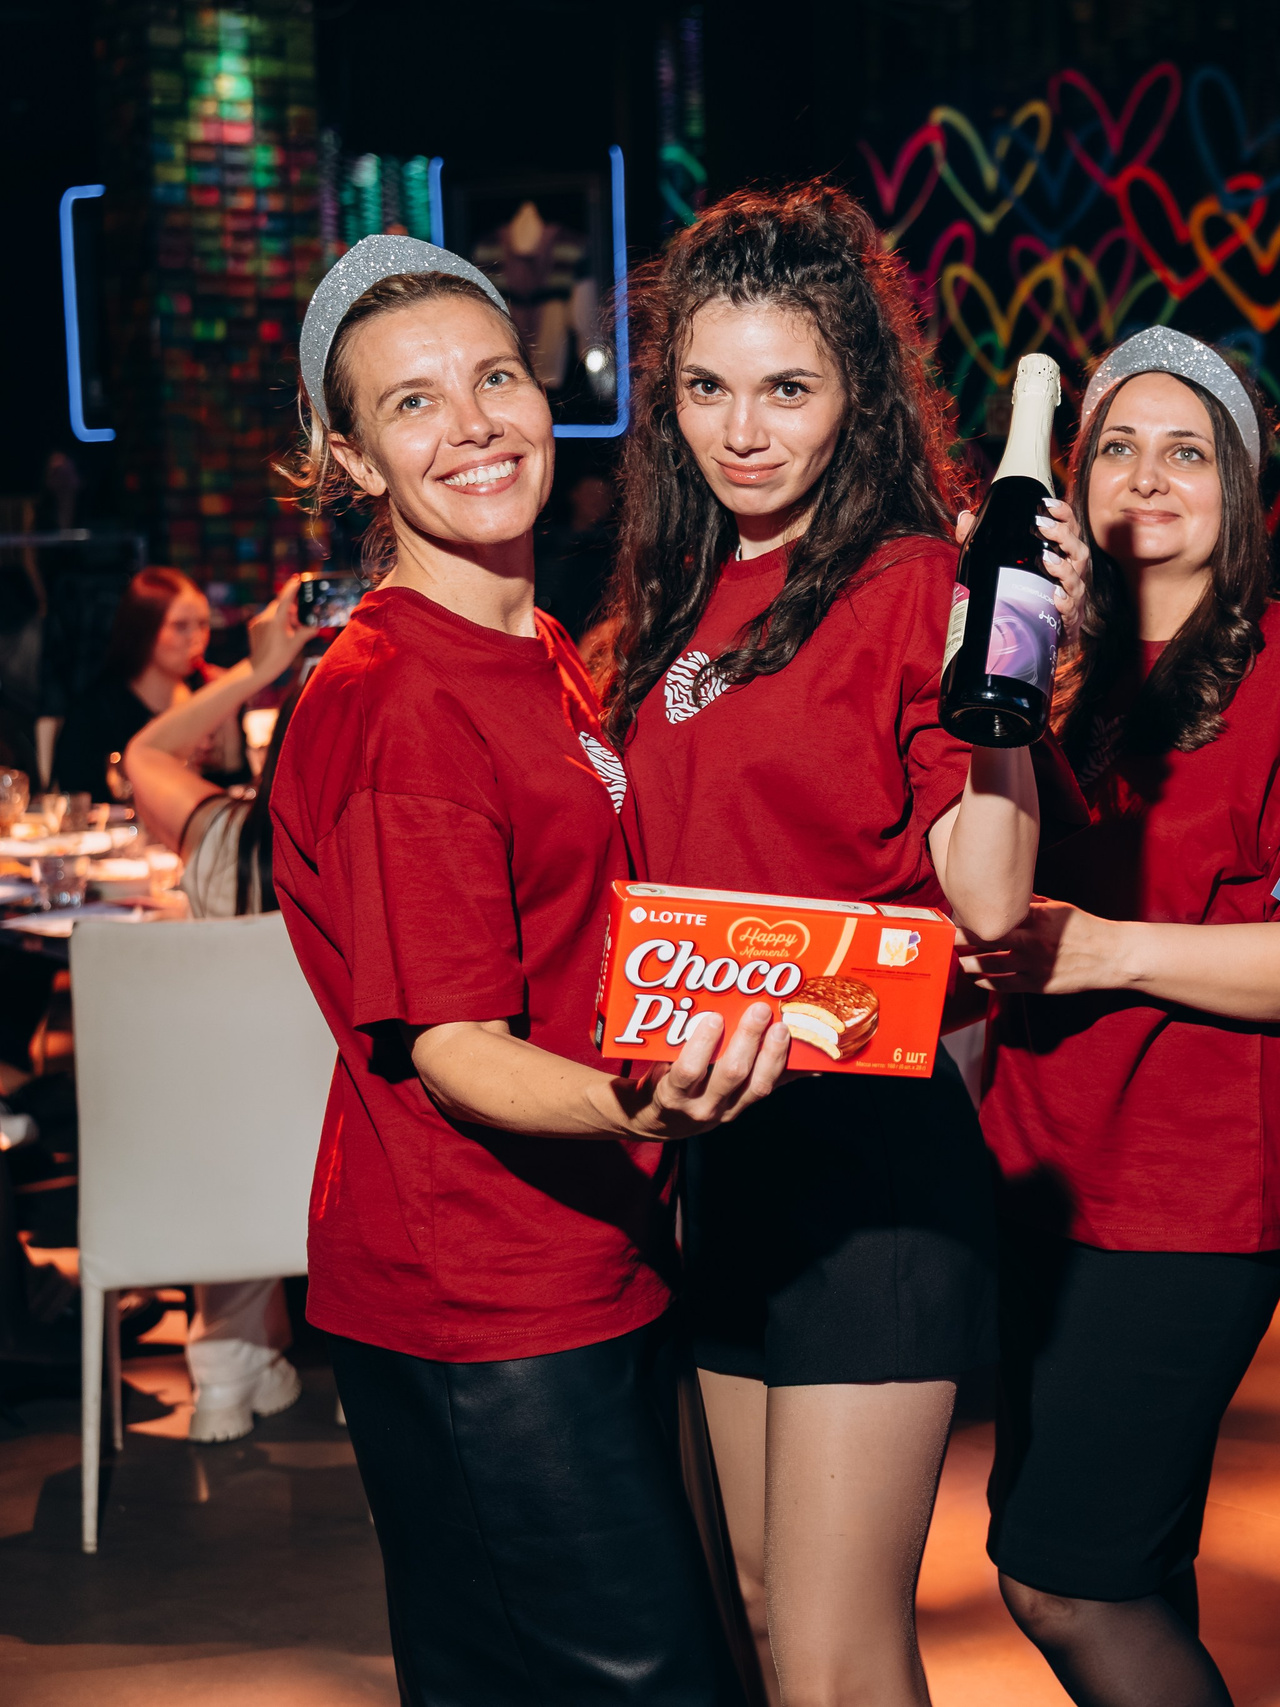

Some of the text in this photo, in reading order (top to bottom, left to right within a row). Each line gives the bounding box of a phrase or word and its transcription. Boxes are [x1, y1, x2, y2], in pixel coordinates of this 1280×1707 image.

[649, 910, 707, 926] LOTTE
[740, 927, 798, 947] Happy
[740, 945, 790, 958] Moments
[624, 938, 801, 998] Choco
[893, 1047, 902, 1062] 6
